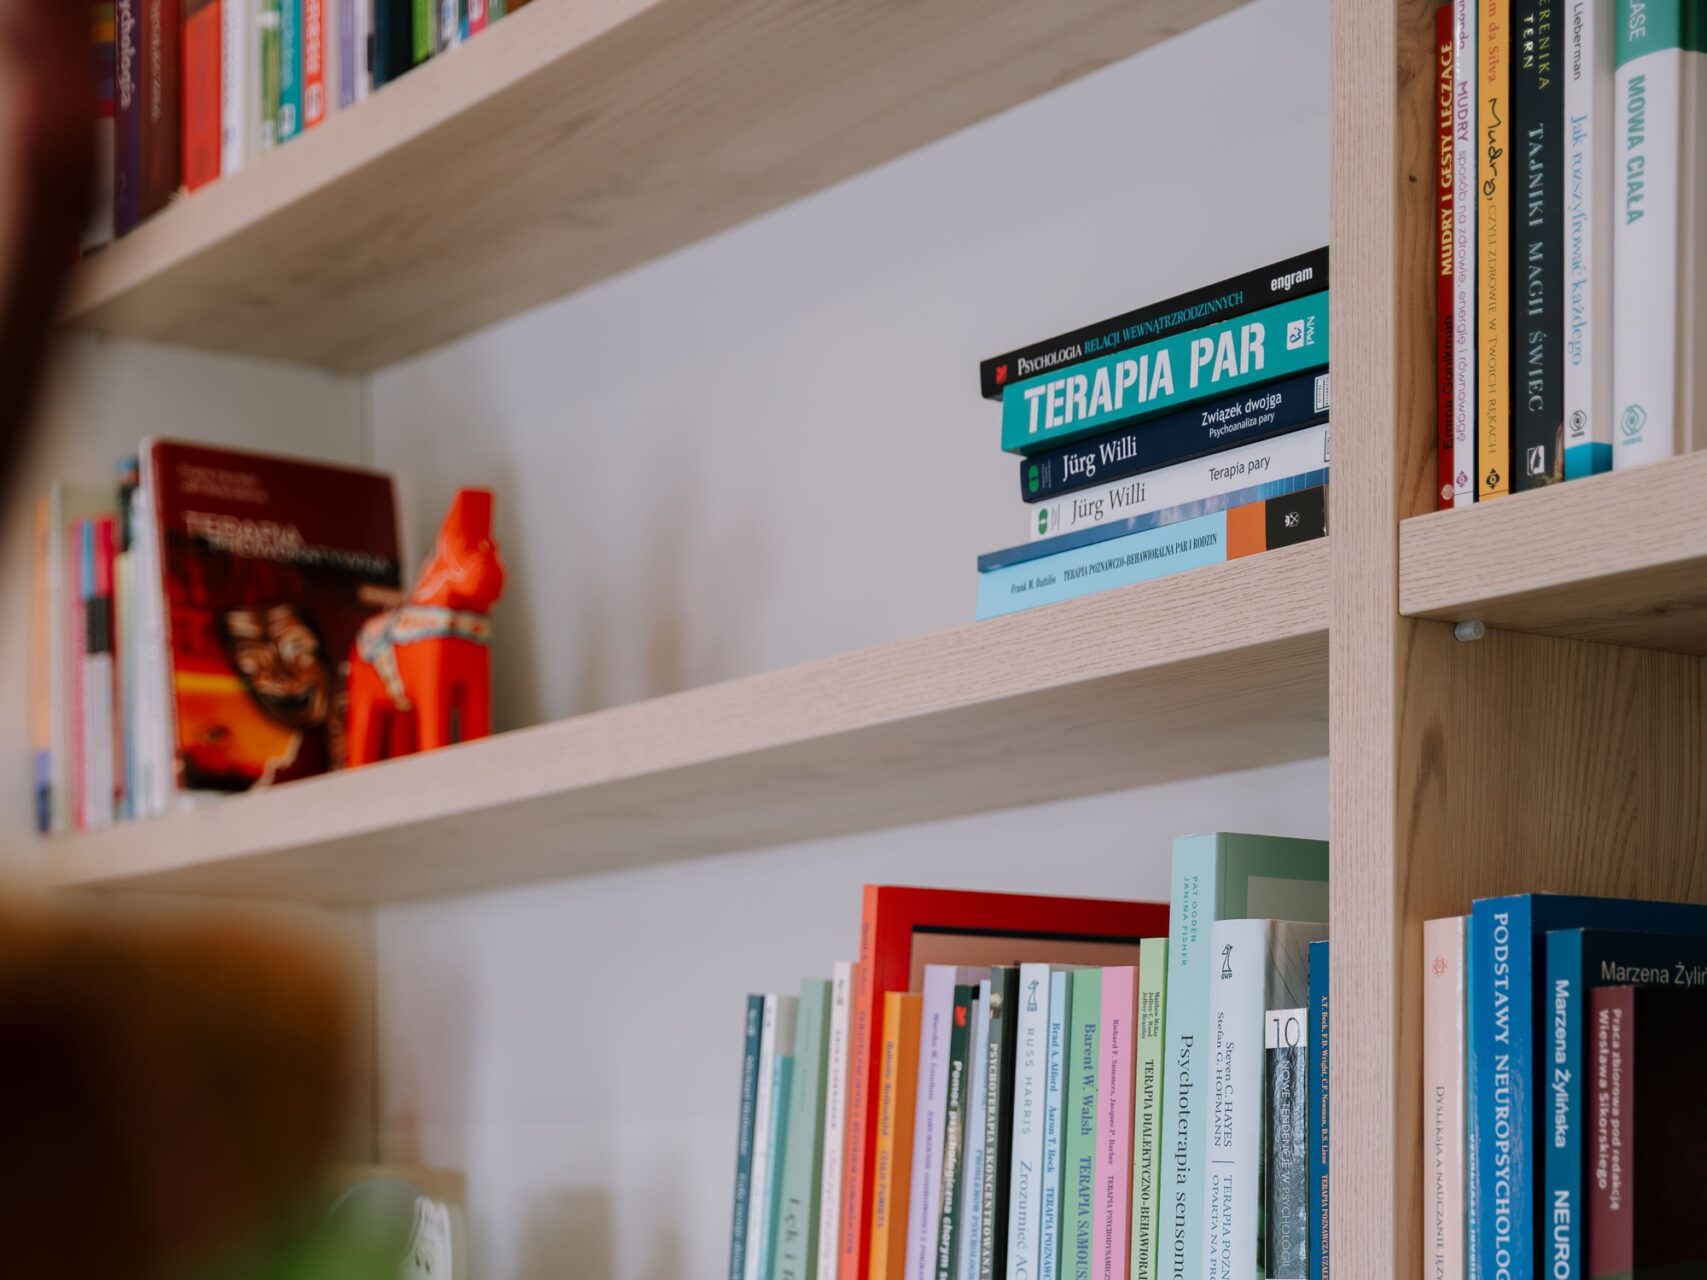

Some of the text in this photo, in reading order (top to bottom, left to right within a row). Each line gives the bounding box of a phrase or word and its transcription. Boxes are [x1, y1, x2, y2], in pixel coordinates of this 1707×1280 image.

[1523, 13, 1534, 69] TERN
[1573, 2, 1584, 81] Lieberman
[1629, 0, 1648, 42] ASE
[1488, 22, 1500, 84] da Silva
[1441, 41, 1453, 276] MUDRY GESTY LECZĄCE
[1626, 74, 1646, 226] MOWA CIAŁA
[1456, 81, 1469, 442] MUDRY sposób równowagę
[1527, 123, 1548, 412] TAJNIKI MAGII ŚWIEC
[1567, 113, 1589, 367] Jak rozszyfrować każdego
[1271, 267, 1313, 292] engram
[1084, 291, 1244, 354] RELACJI WEWNĄTRZRODZINNYCH
[1306, 315, 1315, 346] PWN
[1024, 322, 1265, 434] TERAPIA PAR
[1443, 316, 1453, 394] Gonikman
[1201, 392, 1282, 427] Związek dwojga
[1209, 412, 1275, 438] Psychoanaliza pary
[1486, 398, 1498, 454] RĘKACH
[1062, 453, 1096, 482] Jürg
[1099, 435, 1138, 465] Willi
[1209, 456, 1271, 481] Terapia pary
[1071, 498, 1104, 525] Jürg
[1109, 483, 1145, 510] Willi
[1063, 564, 1088, 582] TERAPIA
[1088, 545, 1174, 575] POZNAWCZO-BEHAWIORALNA
[1193, 533, 1217, 549] RODZIN
[1181, 926, 1189, 966] FISHER
[1190, 901, 1198, 943] OGDEN
[1493, 911, 1510, 1044] PODSTAWY
[1601, 960, 1669, 984] Marzena
[1050, 1023, 1061, 1047] Brad
[1082, 1023, 1096, 1071] Barent
[1111, 1019, 1120, 1049] Richard
[1273, 1016, 1301, 1049] 10
[1554, 979, 1570, 1064] Marzena
[951, 1060, 963, 1107] Pomoc
[986, 1043, 998, 1143] PSYCHOTERAPIA
[1022, 1028, 1035, 1136] RUSS HARRIS
[1049, 1062, 1060, 1092] Alford
[1143, 1059, 1154, 1110] TERAPIA
[1213, 1012, 1225, 1147] Stefan HOFMANN
[1222, 1041, 1235, 1148] Steven HAYES
[1596, 1009, 1610, 1189] Wiesława Sikorskiego
[1048, 1106, 1058, 1135] Aaron
[1080, 1095, 1093, 1136] Walsh
[1174, 1034, 1194, 1185] Psychoterapia
[1434, 1086, 1445, 1155] DYSLEKSJA
[1552, 1069, 1572, 1148] Żylińska
[1608, 1008, 1623, 1210] Praca zbiorowa pod redakcją
[943, 1111, 961, 1214] psychologiczna
[1046, 1149, 1057, 1173] Beck
[1077, 1156, 1092, 1216] TERAPIA
[1281, 1060, 1291, 1267] NOWE TENDENCJE PSYCHOLOGII
[981, 1147, 995, 1274] SKONCENTROWANA
[1017, 1161, 1032, 1249] Zrozumieć
[1044, 1186, 1055, 1230] TERAPIA
[1106, 1175, 1114, 1208] TERAPIA
[1209, 1174, 1219, 1231] OPARTA
[1221, 1175, 1233, 1236] TERAPIA
[1321, 1175, 1329, 1254] TERAPIA POZNAWCZA
[939, 1216, 953, 1268] chorym
